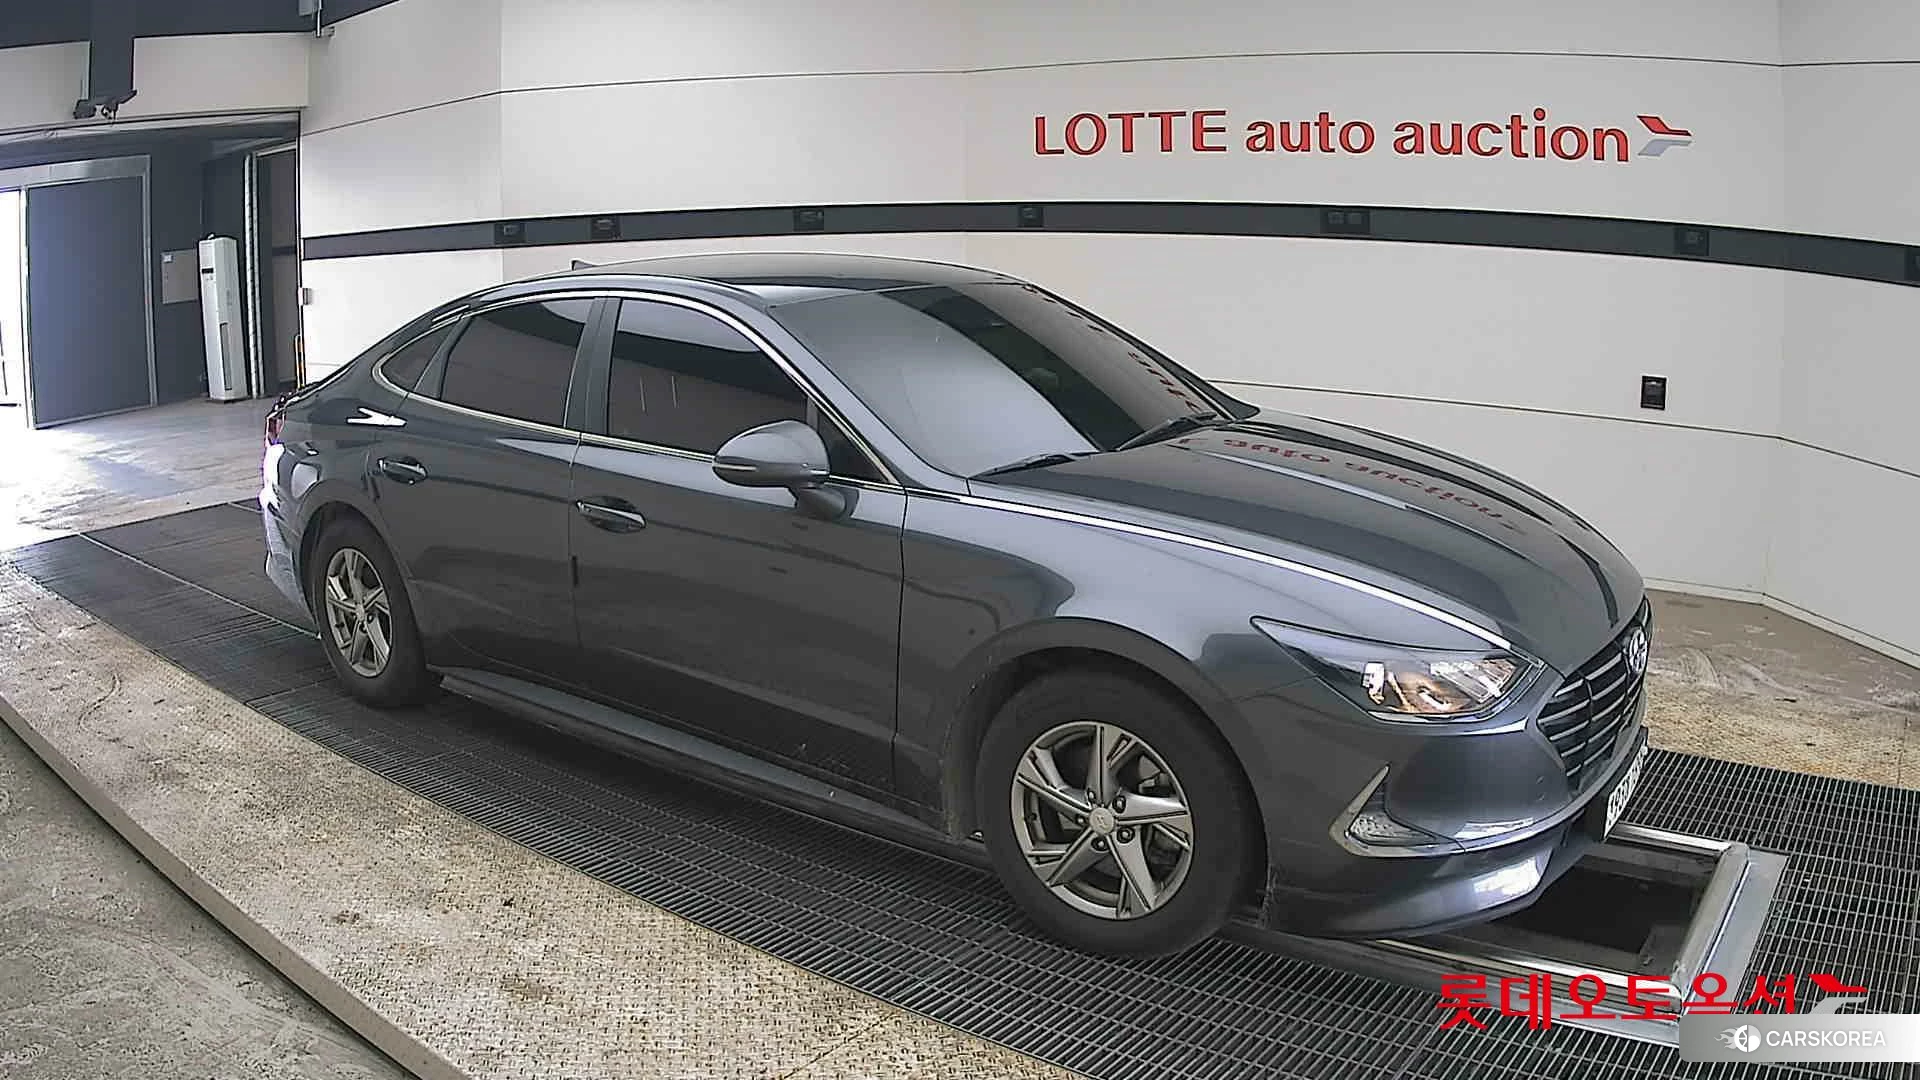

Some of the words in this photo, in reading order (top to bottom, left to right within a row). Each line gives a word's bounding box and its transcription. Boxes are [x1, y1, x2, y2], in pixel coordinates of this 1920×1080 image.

[1034, 110, 1227, 156] LOTTE
[1246, 111, 1376, 153] auto
[1393, 107, 1630, 163] auction
